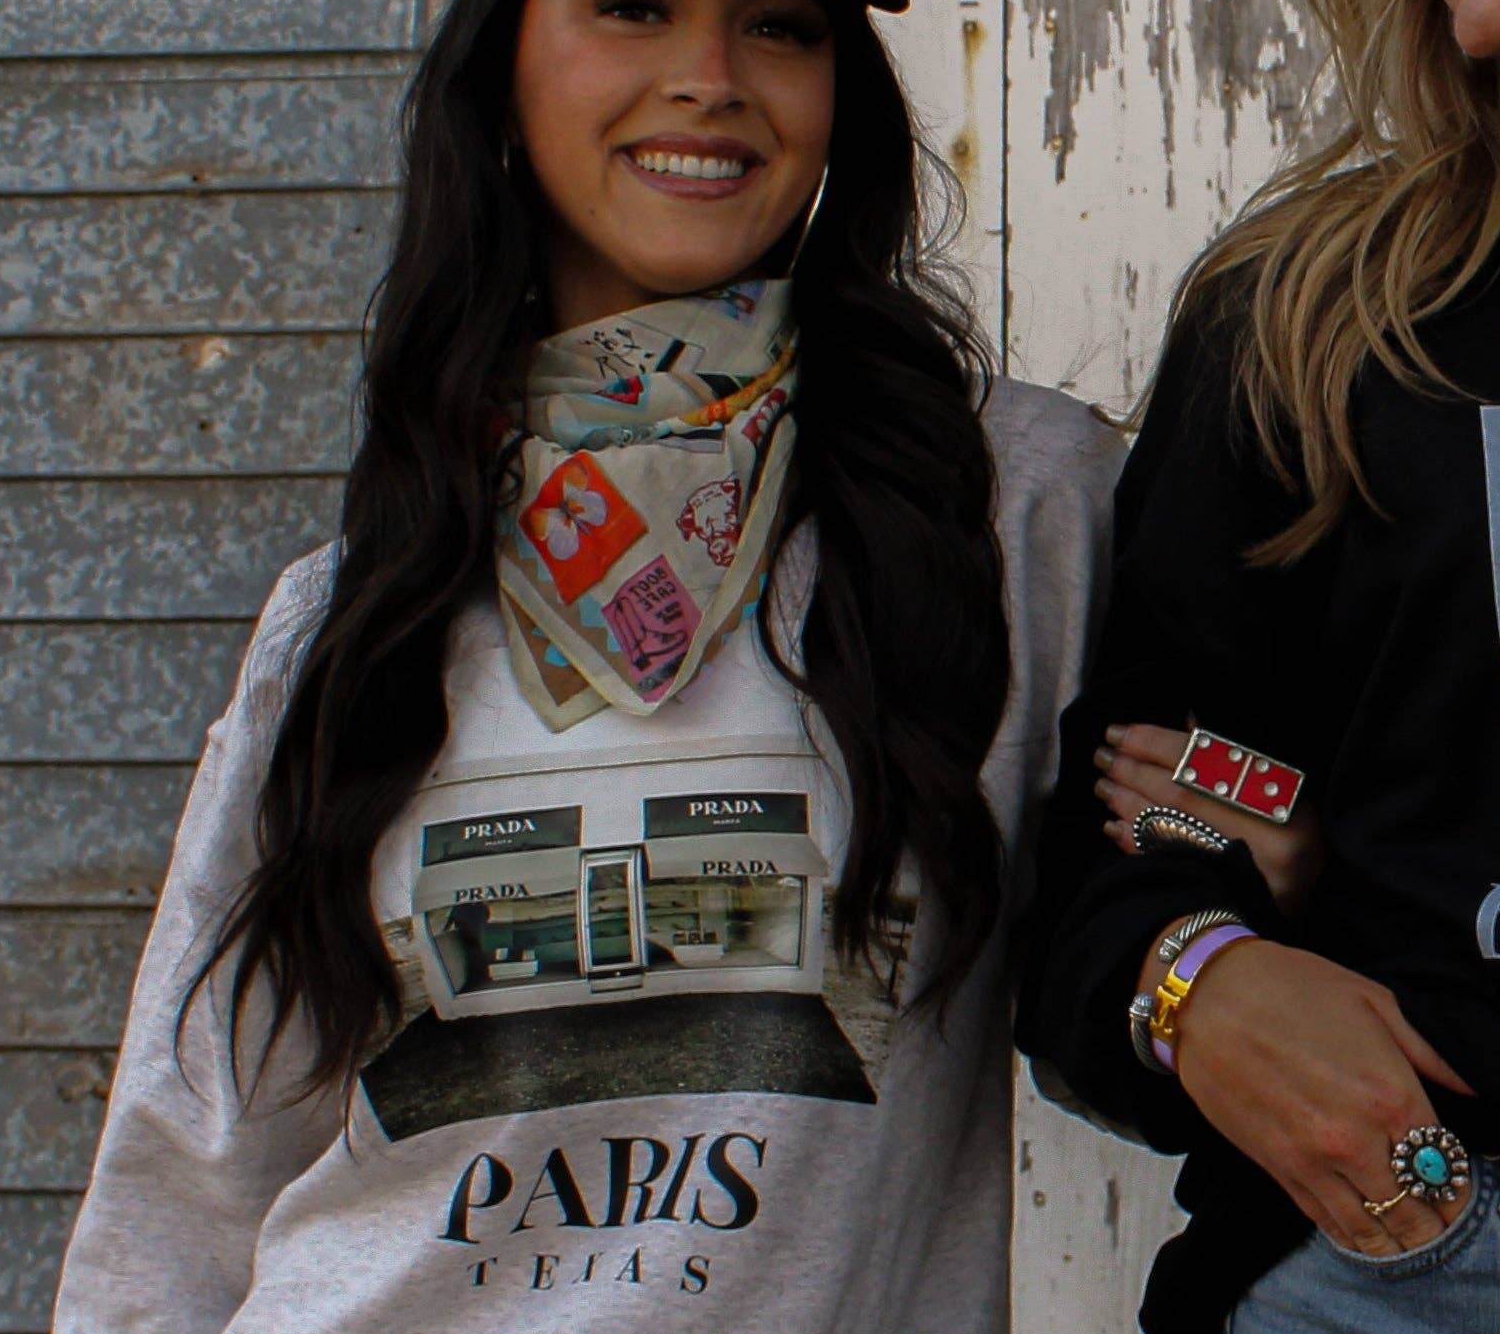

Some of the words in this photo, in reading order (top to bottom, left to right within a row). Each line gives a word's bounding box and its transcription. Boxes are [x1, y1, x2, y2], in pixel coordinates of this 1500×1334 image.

[689, 800, 764, 816] PRADA
[463, 819, 536, 839] PRADA
[702, 860, 778, 875] PRADA
[454, 883, 530, 902] PRADA
[436, 1132, 769, 1245] PARIS
